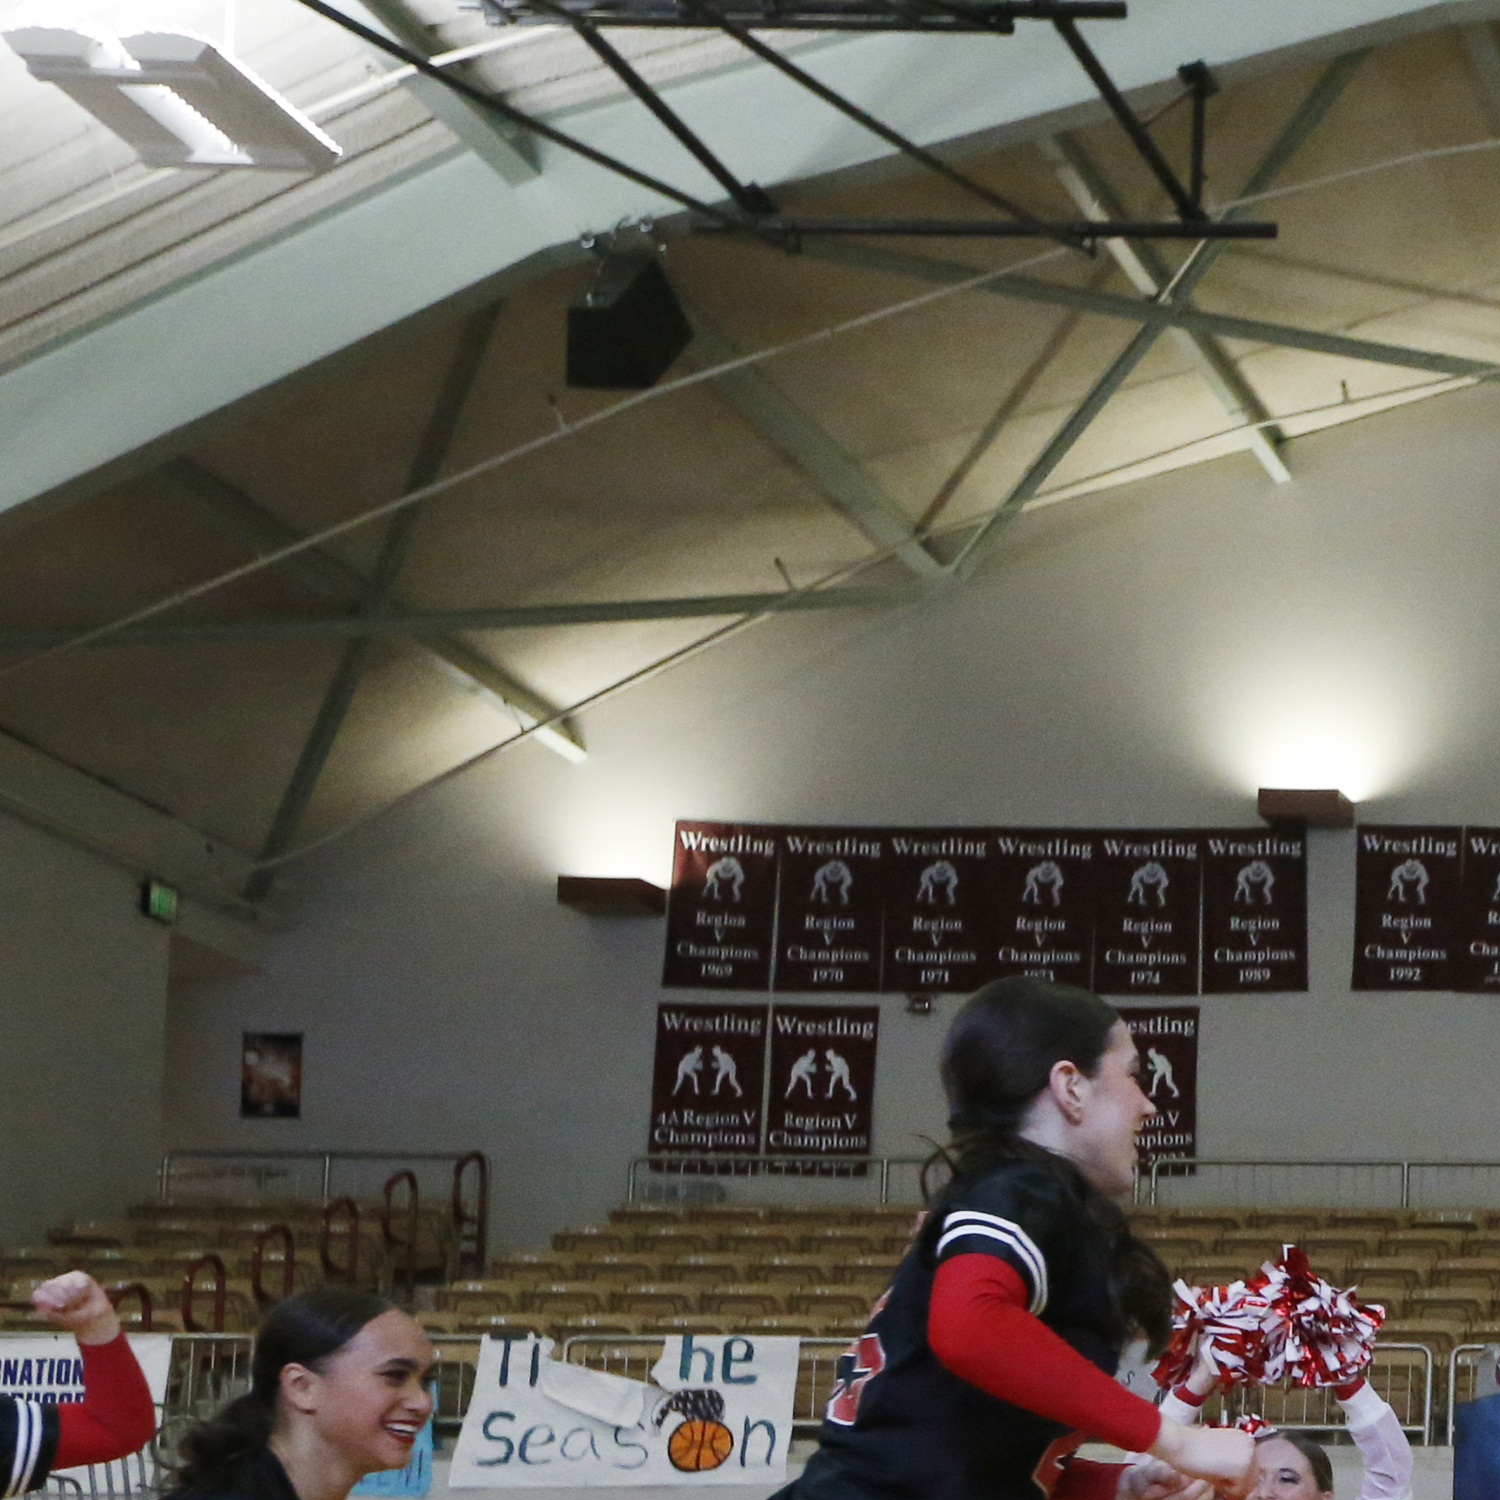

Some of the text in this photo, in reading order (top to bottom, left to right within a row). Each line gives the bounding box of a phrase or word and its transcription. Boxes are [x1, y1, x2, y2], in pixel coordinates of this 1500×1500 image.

[679, 830, 774, 856] Wrestling
[787, 836, 881, 857] Wrestling
[1208, 838, 1301, 857] Wrestling
[1363, 833, 1457, 856] Wrestling
[696, 911, 746, 928] Region
[805, 915, 854, 931] Region
[1230, 917, 1280, 931] Region
[1382, 914, 1431, 929] Region
[677, 943, 759, 959] Champions
[788, 947, 869, 962] Champions
[1214, 948, 1296, 963] Champions
[1365, 945, 1447, 960] Champions
[813, 969, 844, 983] 1970
[1239, 969, 1271, 982] 1989
[1389, 967, 1421, 981] 1992
[663, 1011, 762, 1035] Wrestling
[776, 1014, 875, 1038] Wrestling
[1127, 1016, 1195, 1035] estling
[683, 1110, 738, 1131] Region
[739, 1110, 755, 1125] V
[785, 1112, 857, 1131] Region V
[1167, 1110, 1181, 1127] V
[654, 1128, 755, 1147] Champions
[769, 1131, 867, 1150] Champions
[678, 1333, 758, 1385] he
[0, 1357, 84, 1386] NATION
